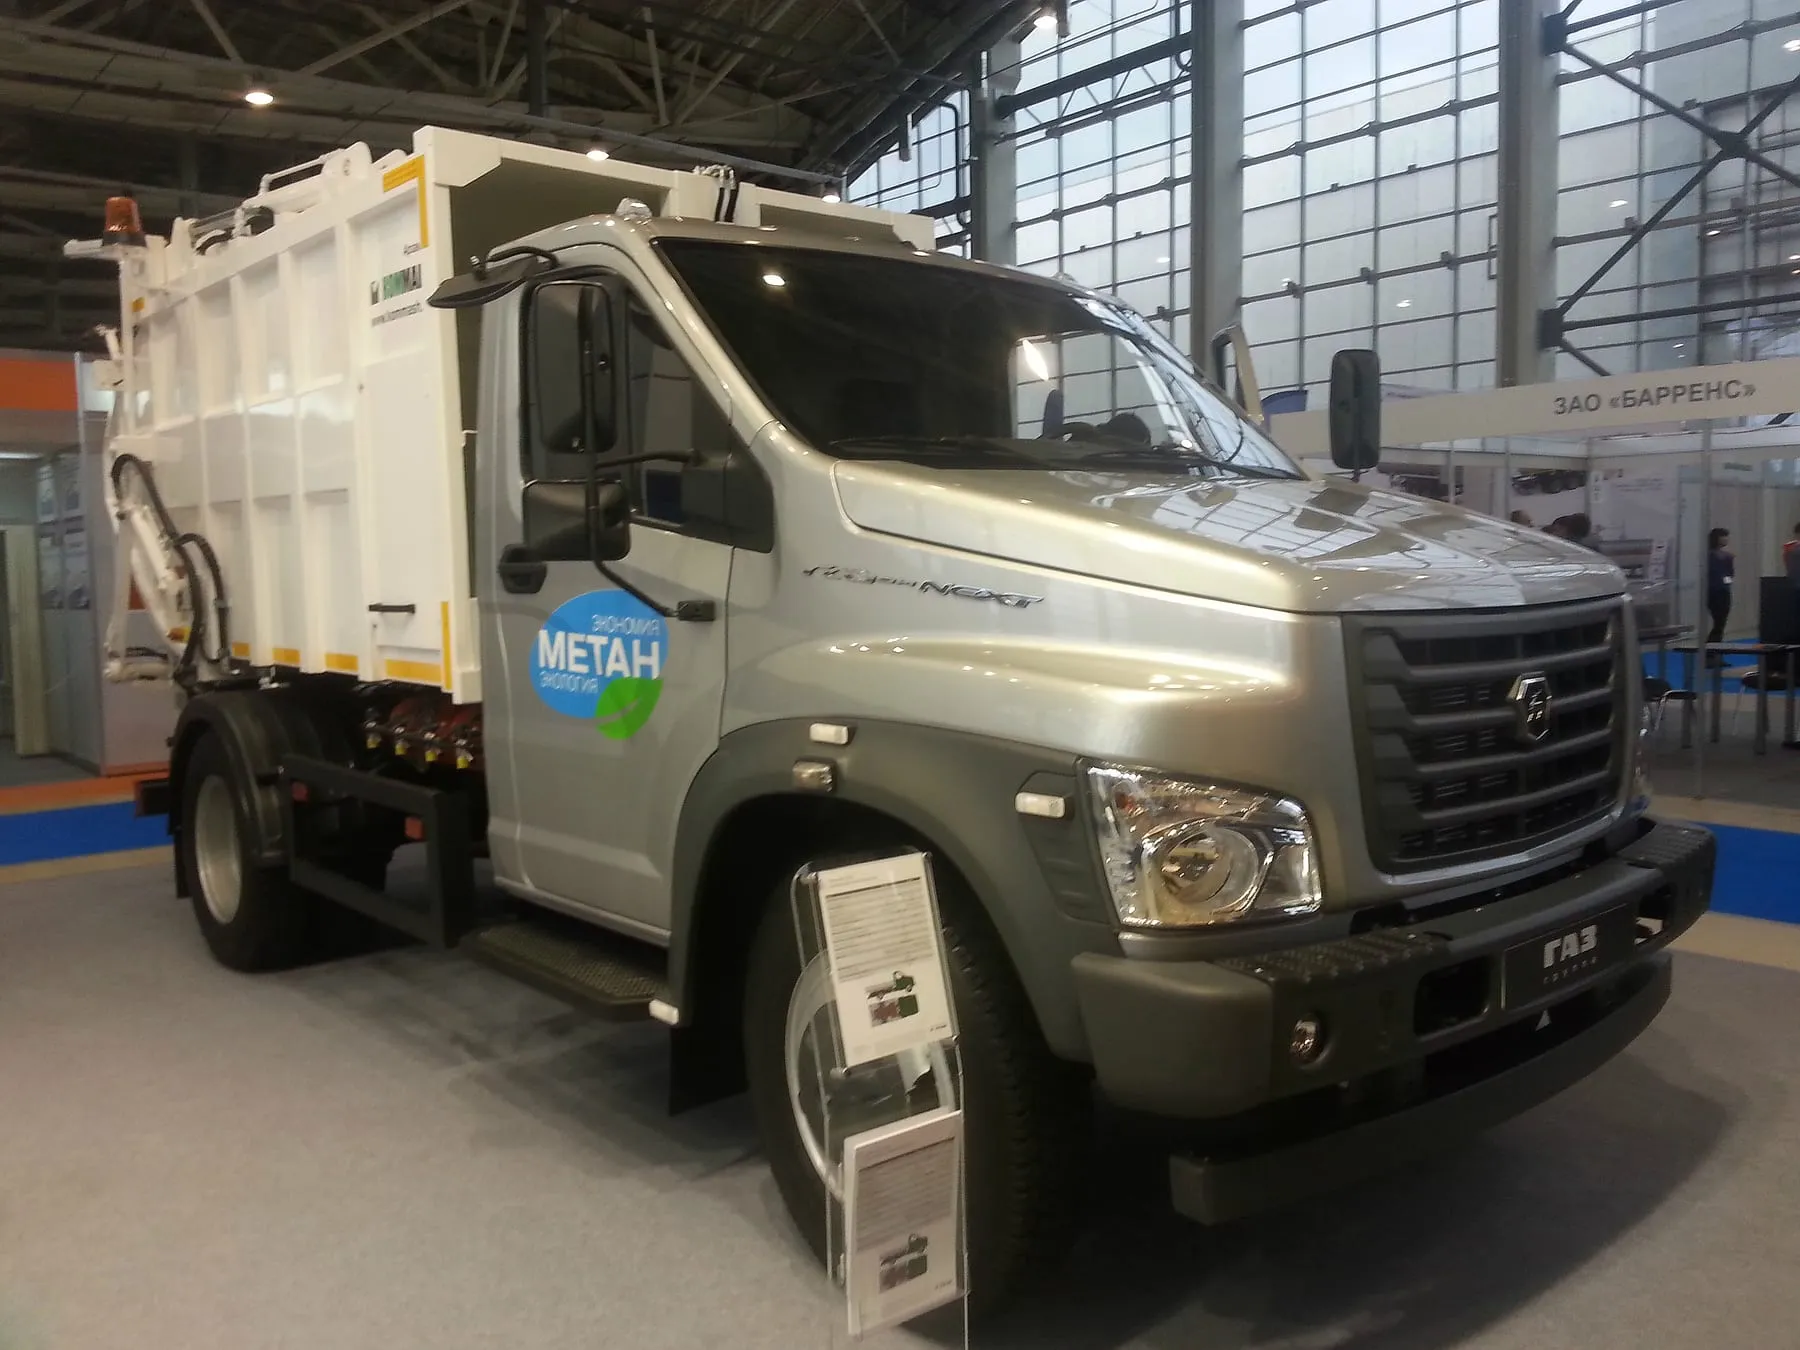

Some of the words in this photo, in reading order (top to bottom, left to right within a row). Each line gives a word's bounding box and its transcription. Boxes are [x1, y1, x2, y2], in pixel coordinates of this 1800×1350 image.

[1554, 394, 1601, 415] ЗАО
[1609, 379, 1756, 409] «БАРРЕНС»
[538, 629, 660, 680] МЕТАН
[1543, 924, 1598, 968] ГАЗ
